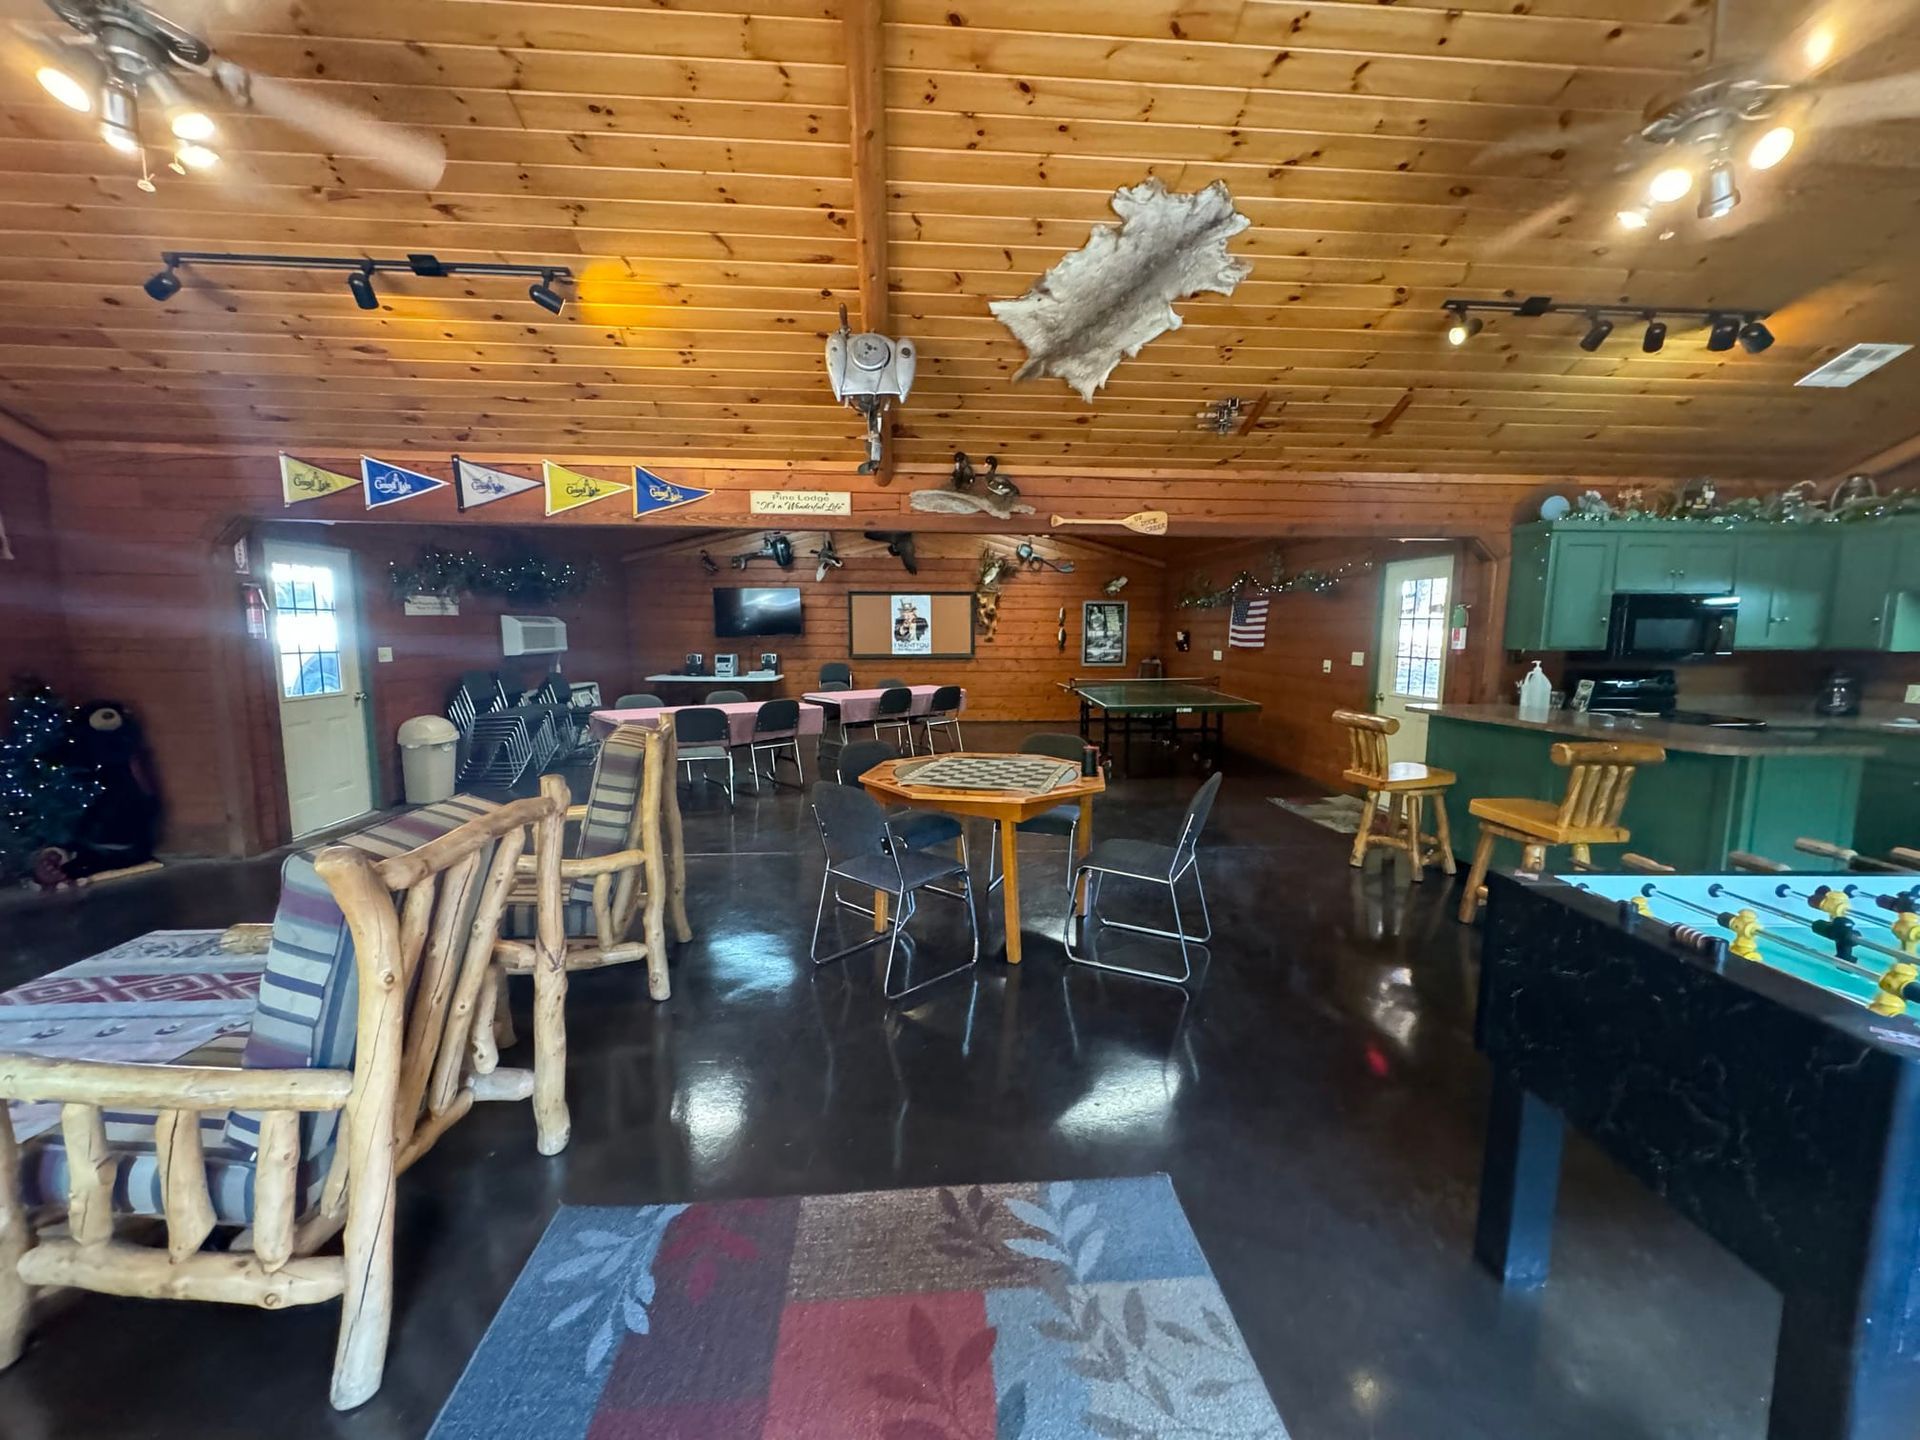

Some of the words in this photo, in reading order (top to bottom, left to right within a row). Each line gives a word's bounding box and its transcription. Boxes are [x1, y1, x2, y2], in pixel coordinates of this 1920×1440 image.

[772, 493, 795, 501] Pine
[797, 494, 830, 502] Lodge
[784, 502, 825, 512] Wonderful
